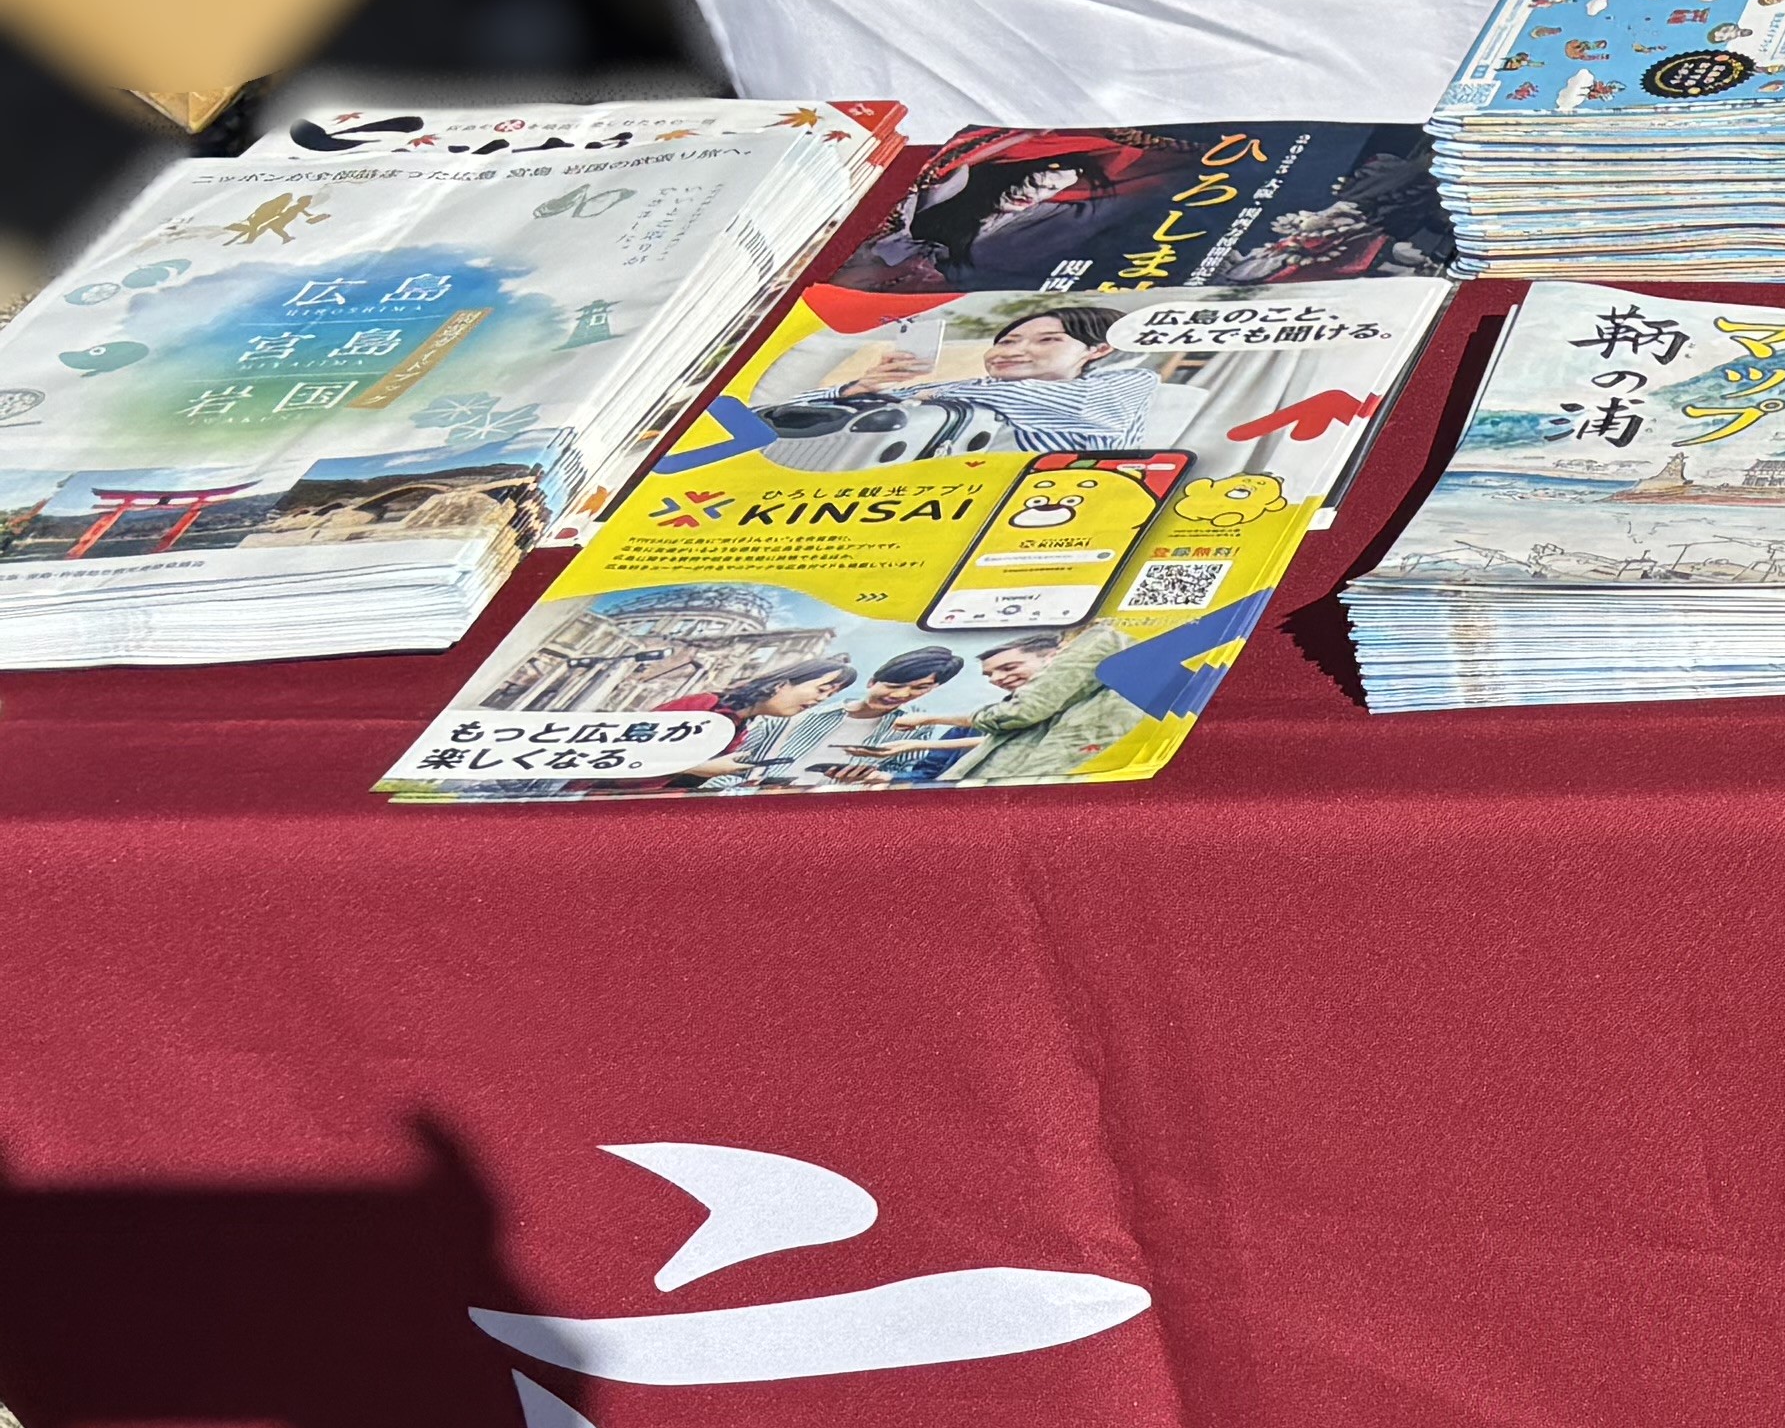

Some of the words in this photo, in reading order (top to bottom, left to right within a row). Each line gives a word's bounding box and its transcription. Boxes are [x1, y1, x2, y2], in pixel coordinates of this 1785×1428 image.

[282, 273, 452, 307] 広島
[1147, 307, 1340, 328] 広島のこと、
[237, 328, 402, 362] 宮島
[1131, 324, 1393, 346] なんでも聞ける。
[1542, 304, 1691, 450] 鞆の浦
[175, 380, 360, 418] 岩国
[763, 484, 984, 501] ひろしま観光アプリ
[738, 498, 974, 527] KINSAI
[450, 717, 706, 750] もっと広島が
[417, 746, 644, 774] 楽しくなる。
